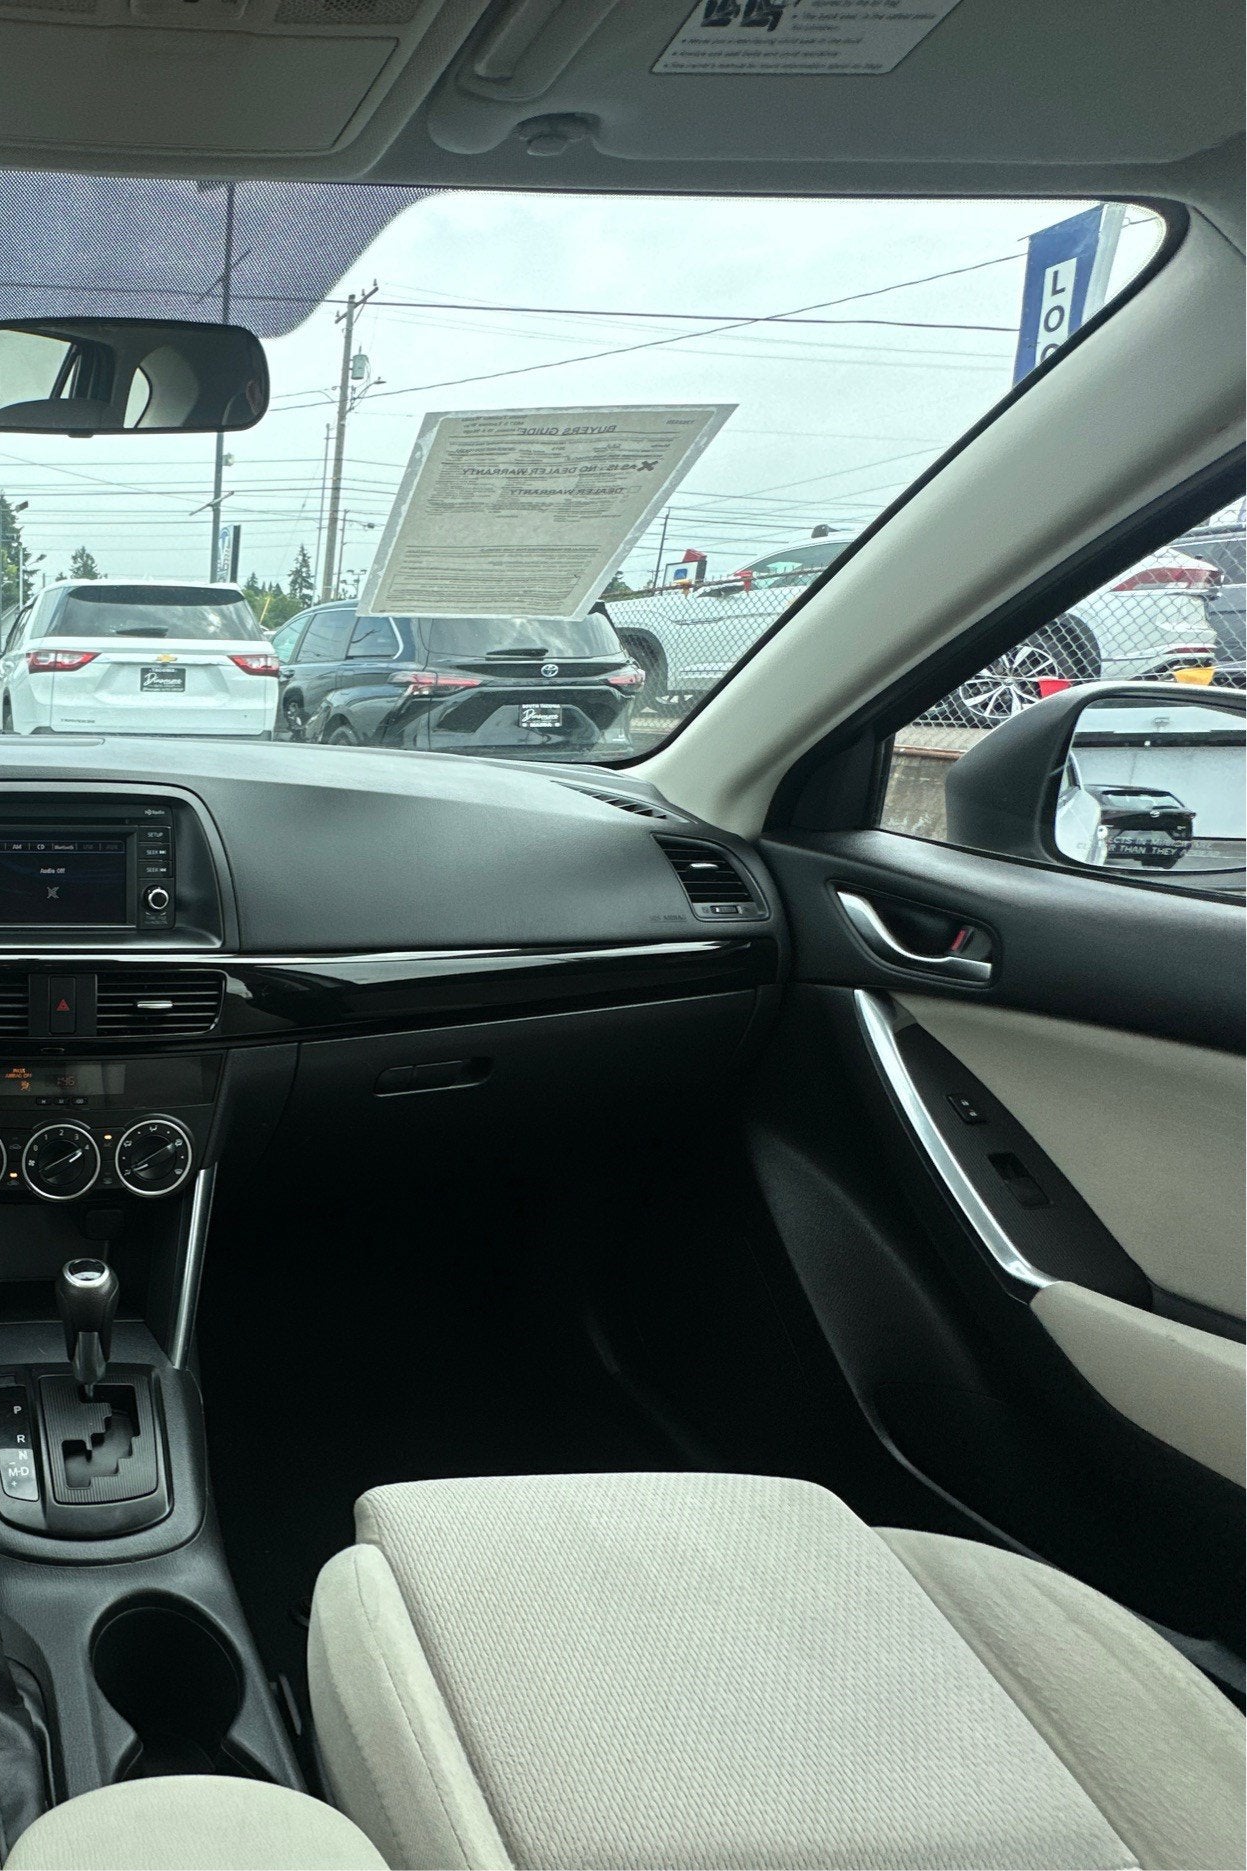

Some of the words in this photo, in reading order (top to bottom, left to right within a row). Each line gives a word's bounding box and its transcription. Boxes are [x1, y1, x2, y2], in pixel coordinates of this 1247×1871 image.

[1120, 844, 1146, 854] THAN
[1152, 846, 1177, 856] THEY
[13, 1405, 22, 1415] P
[16, 1434, 26, 1444] R
[18, 1451, 28, 1460] N
